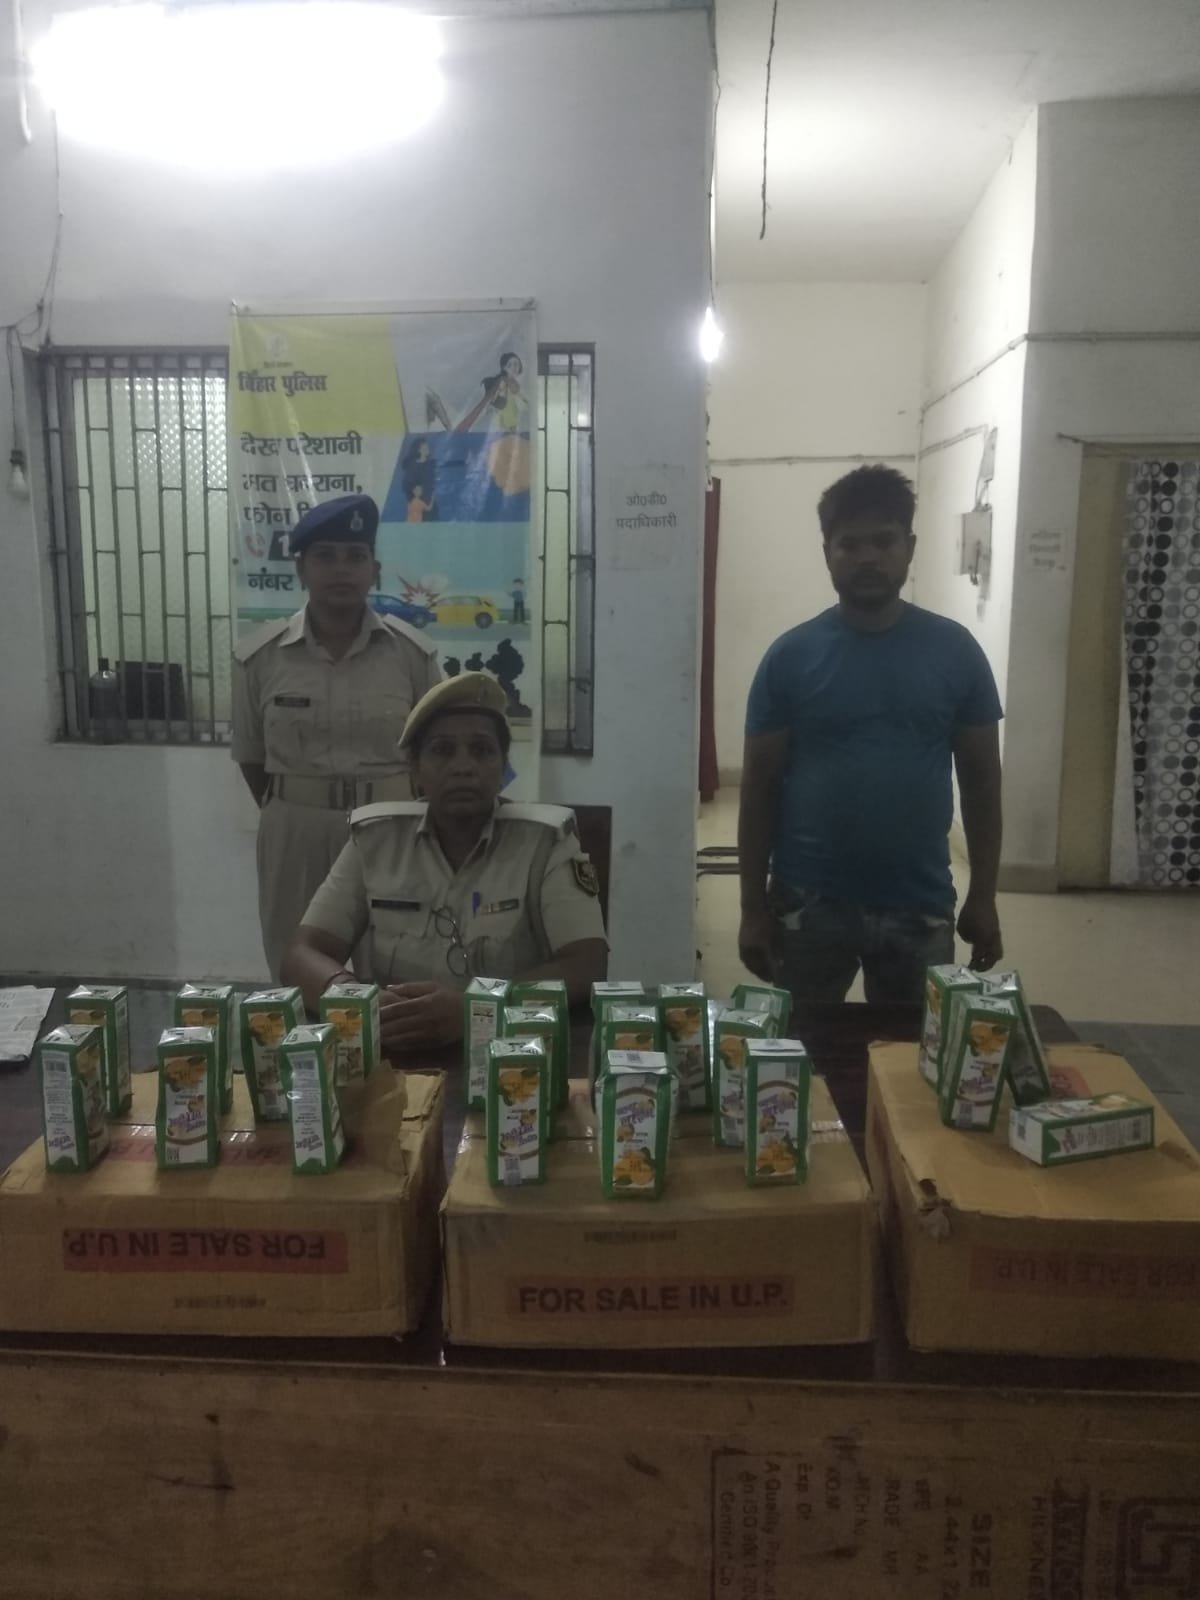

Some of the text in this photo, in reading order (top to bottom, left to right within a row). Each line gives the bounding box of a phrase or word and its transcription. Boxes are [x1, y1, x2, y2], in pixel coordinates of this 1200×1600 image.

[281, 371, 327, 397] पुलिस
[285, 430, 363, 455] परेशानी
[243, 502, 291, 525] फोन
[247, 567, 294, 592] नंबर
[128, 1231, 160, 1257] IN
[170, 1231, 252, 1259] SALE
[264, 1233, 325, 1260] FOR
[518, 1286, 586, 1314] FOR
[596, 1285, 681, 1313] SALE
[690, 1284, 721, 1309] IN
[970, 1513, 993, 1588] SIZE
